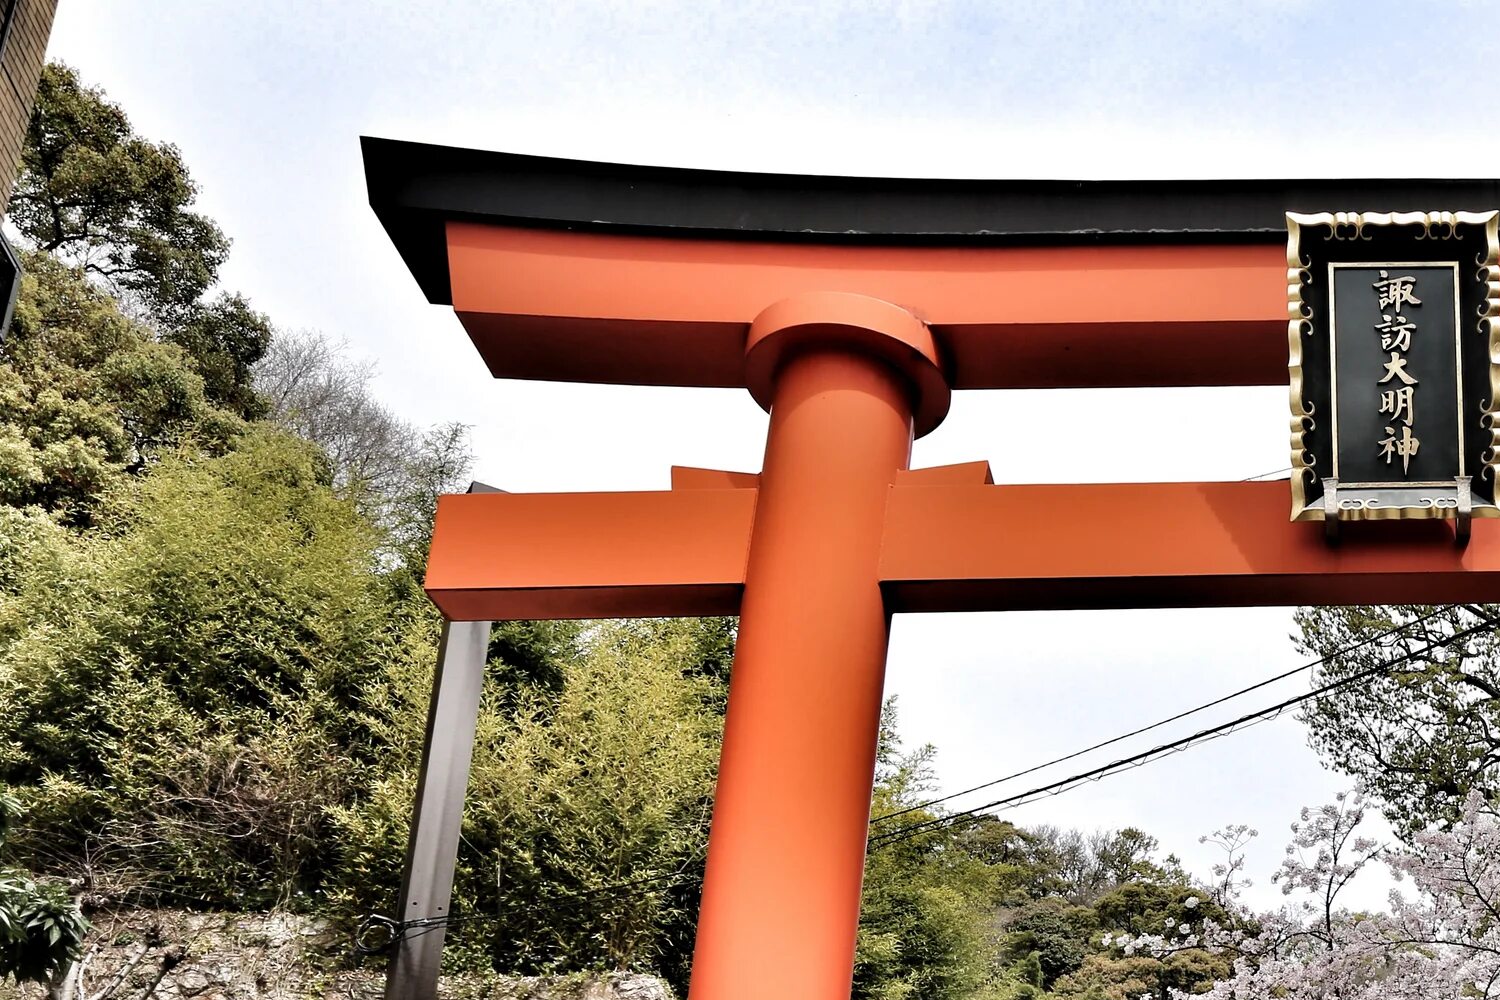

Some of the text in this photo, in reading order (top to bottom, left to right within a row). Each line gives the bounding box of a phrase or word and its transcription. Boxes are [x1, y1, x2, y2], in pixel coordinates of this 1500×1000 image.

[1371, 269, 1423, 477] 諏訪大明神
